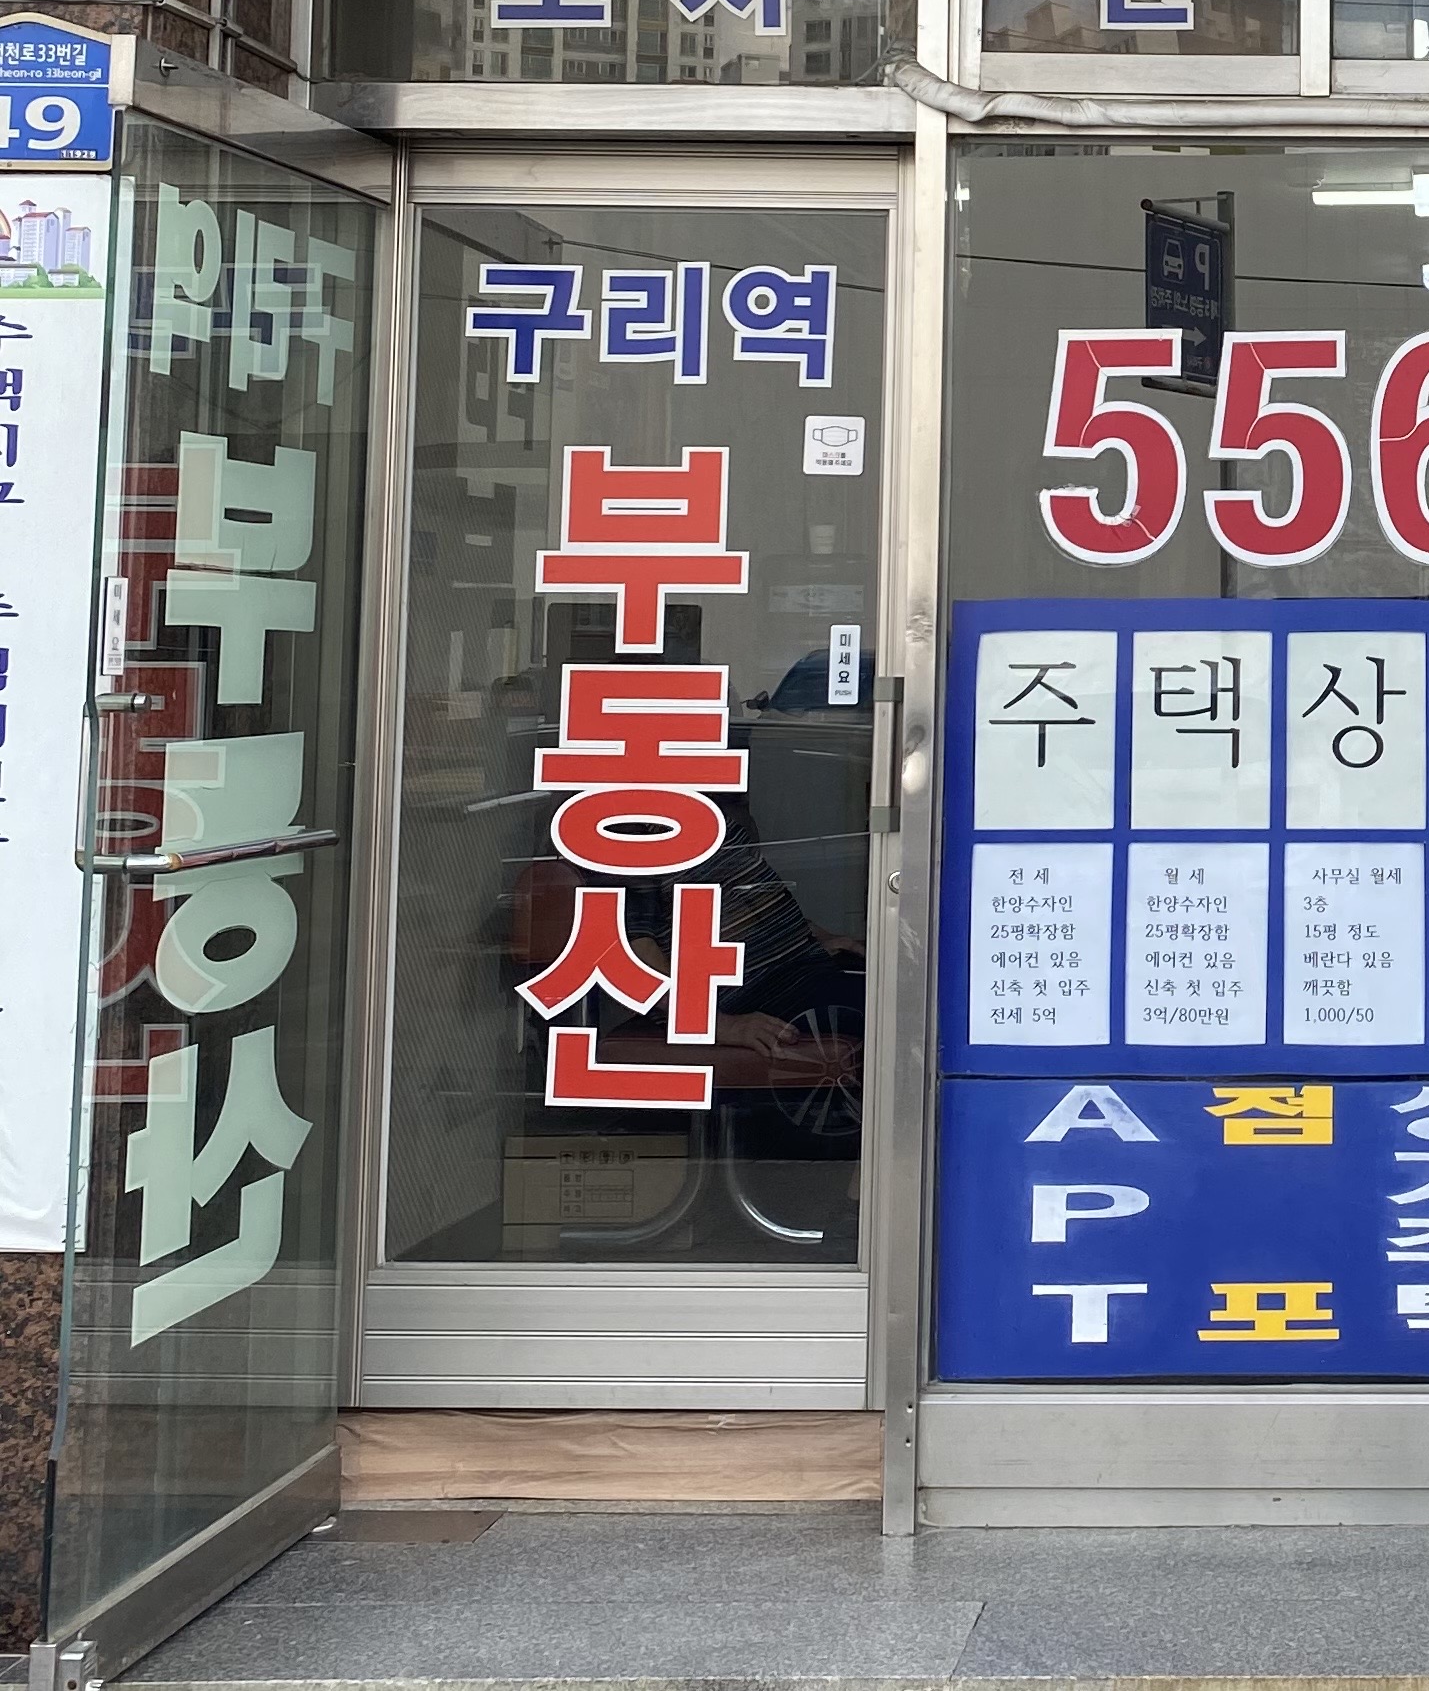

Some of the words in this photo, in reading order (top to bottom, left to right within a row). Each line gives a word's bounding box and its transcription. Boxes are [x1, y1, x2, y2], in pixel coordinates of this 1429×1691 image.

[0, 43, 87, 66] 천로33번길
[465, 260, 838, 389] 구리역
[513, 445, 752, 1112] 부동산
[1311, 867, 1360, 886] 사무실
[1369, 867, 1402, 885] 월세
[991, 894, 1073, 914] 한양수자인
[1146, 895, 1228, 914] 한양수자인
[1303, 895, 1330, 914] 3층
[990, 923, 1077, 942] 25평확장함
[1145, 923, 1230, 942] 25평확장함
[1305, 922, 1337, 941] 15평
[1347, 923, 1381, 941] 정도
[990, 951, 1039, 969] 에어컨
[1049, 950, 1083, 969] 있음
[1144, 950, 1193, 969] 에어컨
[1203, 951, 1236, 970] 있음
[1302, 950, 1353, 969] 베란다
[1362, 951, 1395, 969] 있음
[990, 979, 1024, 997] 신축
[1032, 978, 1048, 997] 첫
[1058, 978, 1091, 997] 입주
[1143, 978, 1177, 997] 신축
[1186, 979, 1201, 998] 첫
[1211, 979, 1244, 998] 입주
[1302, 978, 1353, 997] 깨끗함
[990, 1006, 1023, 1025] 전세
[1032, 1007, 1056, 1026] 5억
[1142, 1006, 1230, 1026] 3억/80만원
[1304, 1006, 1375, 1025] 1,000/50
